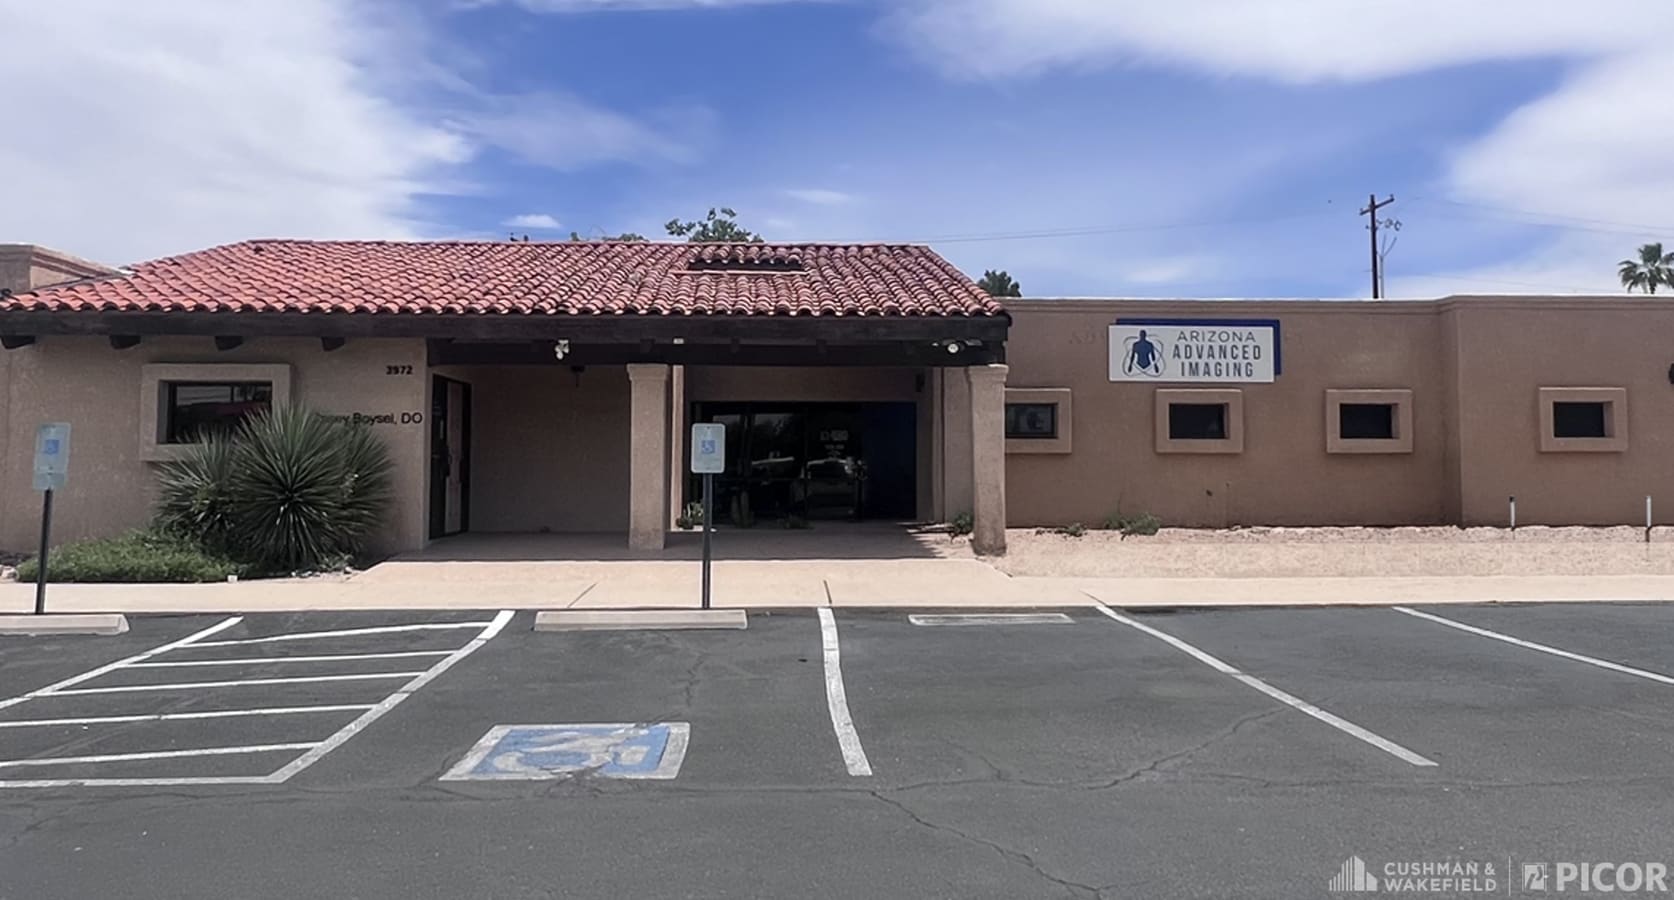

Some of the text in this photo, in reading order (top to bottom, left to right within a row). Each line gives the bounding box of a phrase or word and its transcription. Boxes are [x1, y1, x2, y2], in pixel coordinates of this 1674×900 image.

[1176, 330, 1257, 343] ARIZONA
[1172, 345, 1262, 360] ADVANCED
[385, 365, 413, 375] 3972
[1180, 361, 1254, 377] IMAGING
[401, 412, 422, 424] DO
